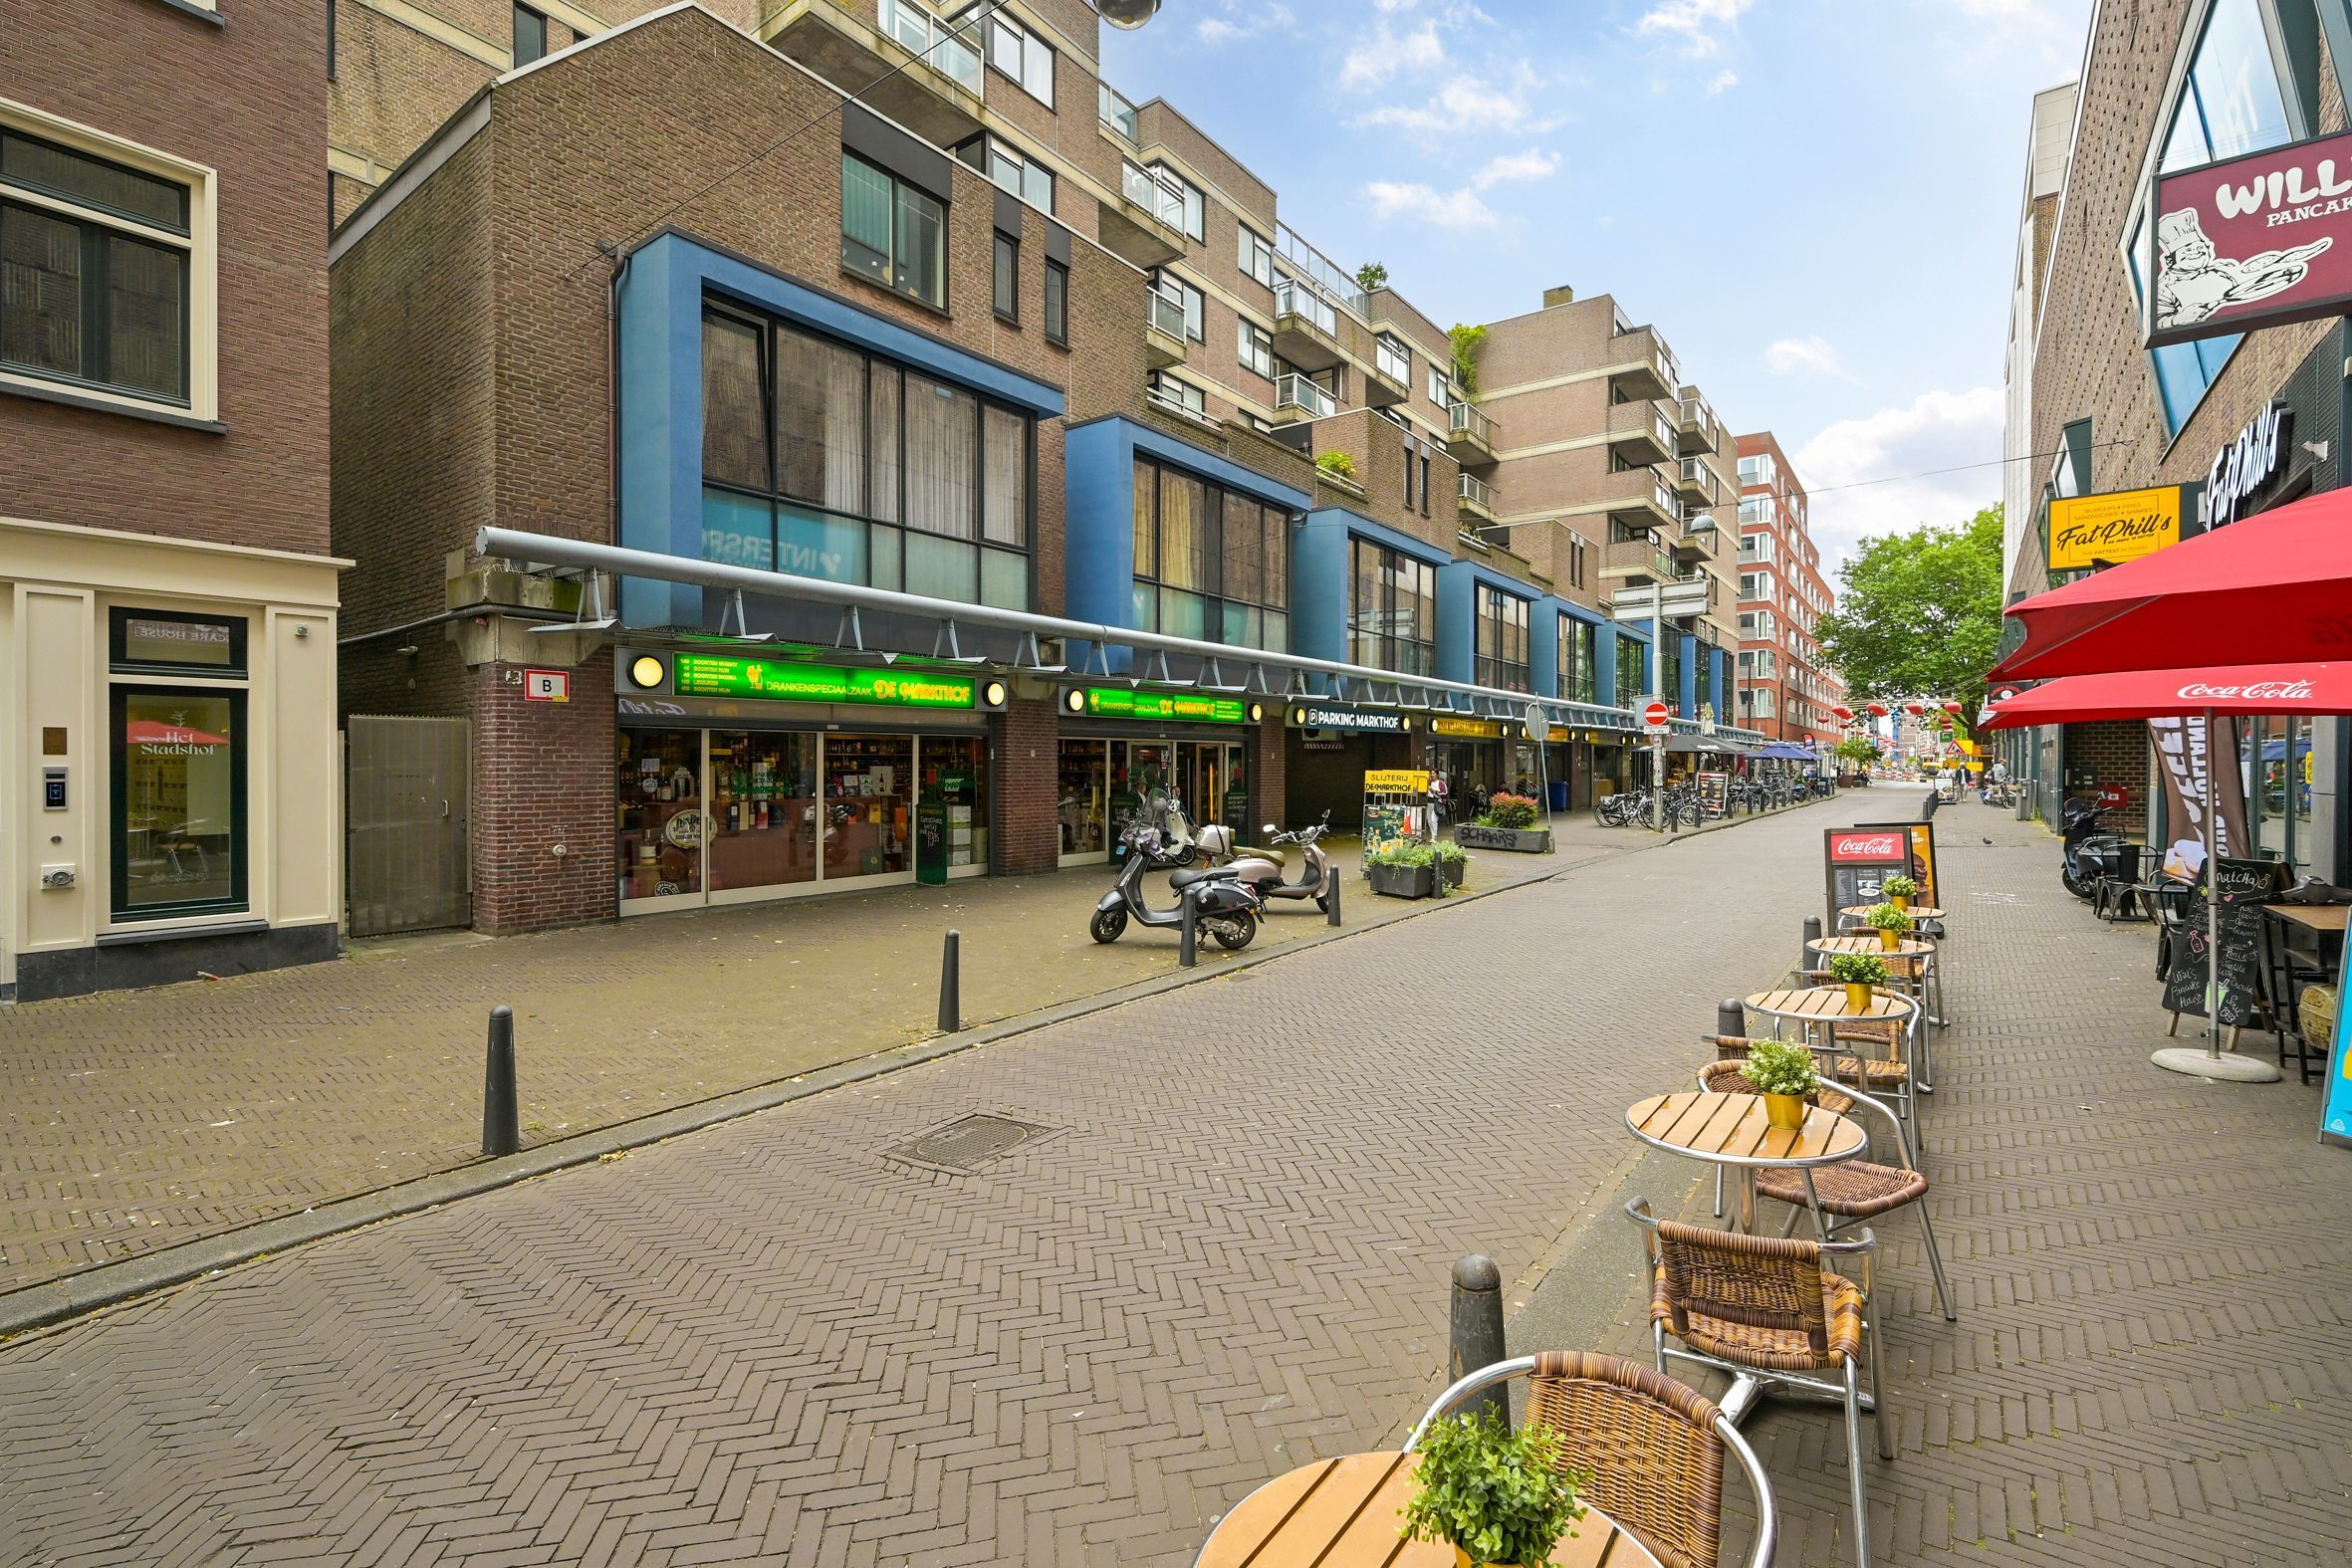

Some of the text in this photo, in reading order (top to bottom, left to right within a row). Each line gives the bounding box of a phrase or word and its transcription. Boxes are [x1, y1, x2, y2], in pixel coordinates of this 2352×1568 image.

[2216, 159, 2352, 219] WILL
[542, 679, 553, 693] B
[766, 679, 971, 701] DRANKENSPECIAALZAAK DE MARKTHOF
[2177, 679, 2317, 699] Coca-Cola
[1318, 711, 1355, 727] PARKING
[1356, 714, 1399, 729] MARKTHOF
[164, 731, 194, 743] Het
[141, 743, 217, 755] Stadshof
[1370, 774, 1409, 783] SLIJTERIJ
[1837, 837, 1895, 855] Coca-Cola
